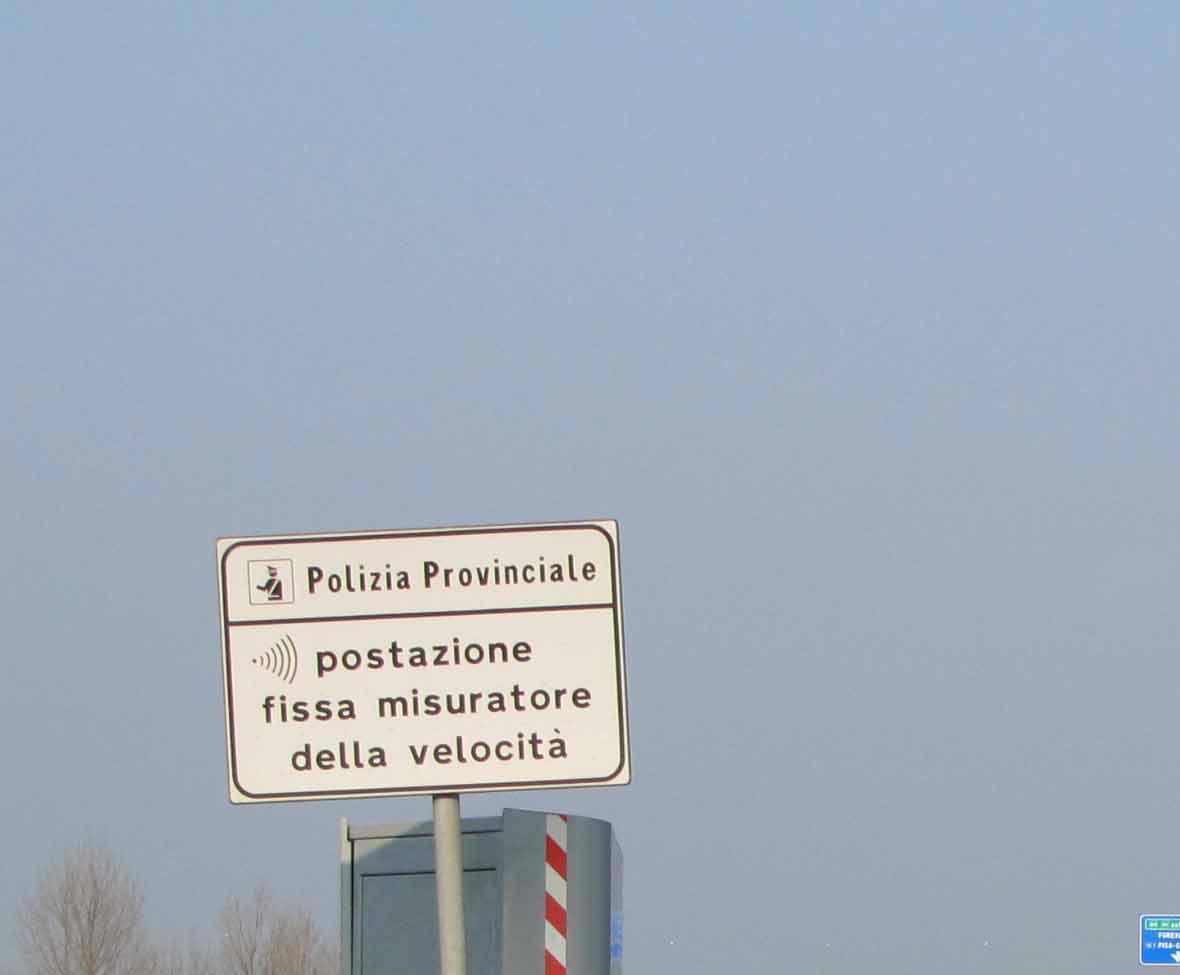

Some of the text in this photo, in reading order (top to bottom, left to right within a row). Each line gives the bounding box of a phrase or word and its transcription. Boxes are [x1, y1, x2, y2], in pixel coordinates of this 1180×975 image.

[307, 554, 597, 594] Polizia Provinciale
[315, 637, 532, 678] postazione
[262, 684, 592, 723] fissa misuratore
[291, 728, 568, 772] della velocità
